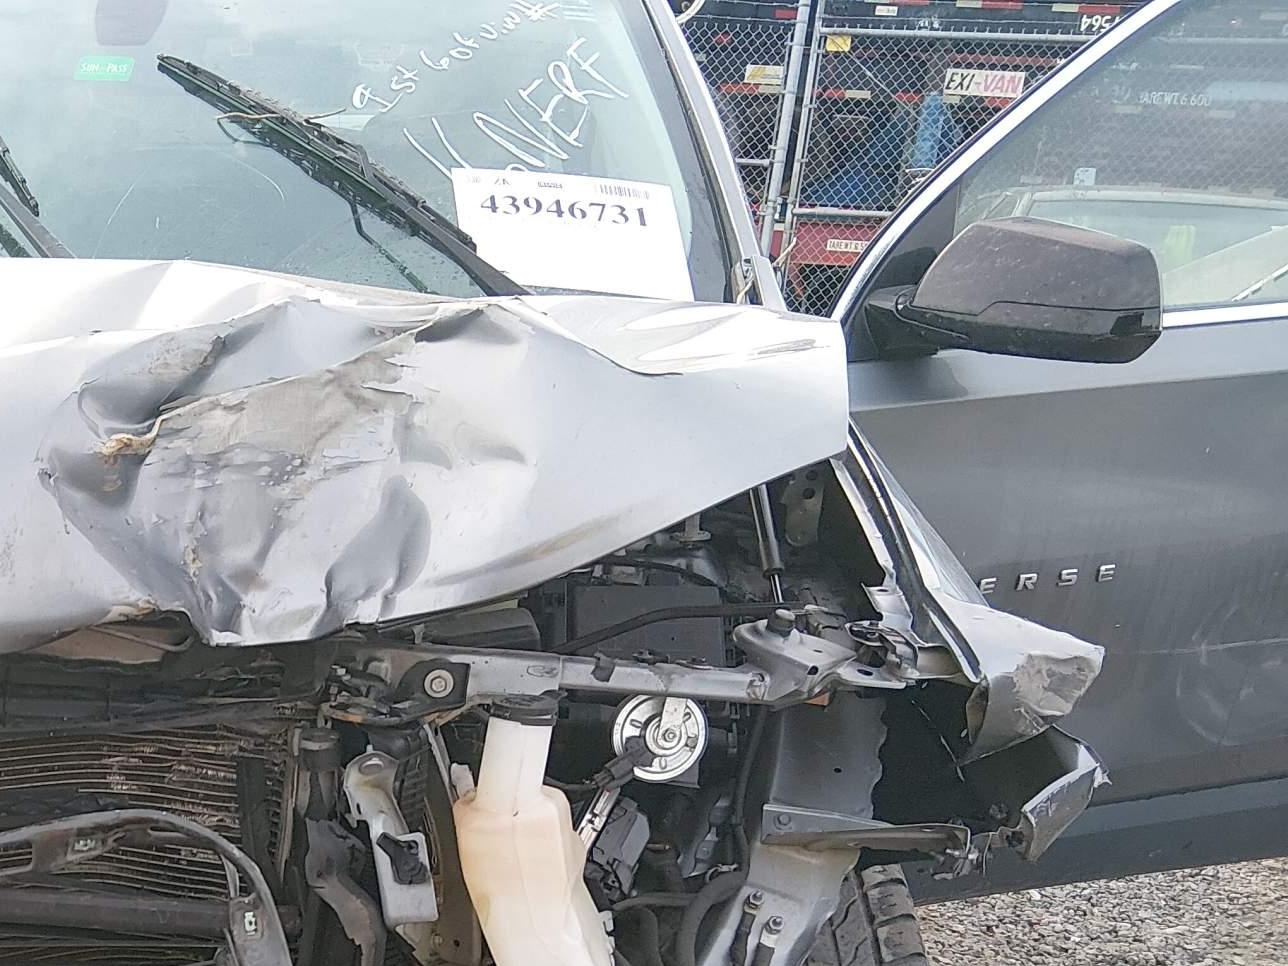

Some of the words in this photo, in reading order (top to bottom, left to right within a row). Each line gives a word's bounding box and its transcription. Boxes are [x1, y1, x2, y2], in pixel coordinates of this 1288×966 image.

[1080, 14, 1119, 32] 564
[480, 194, 648, 227] 43946731
[978, 563, 1116, 595] ERSE
